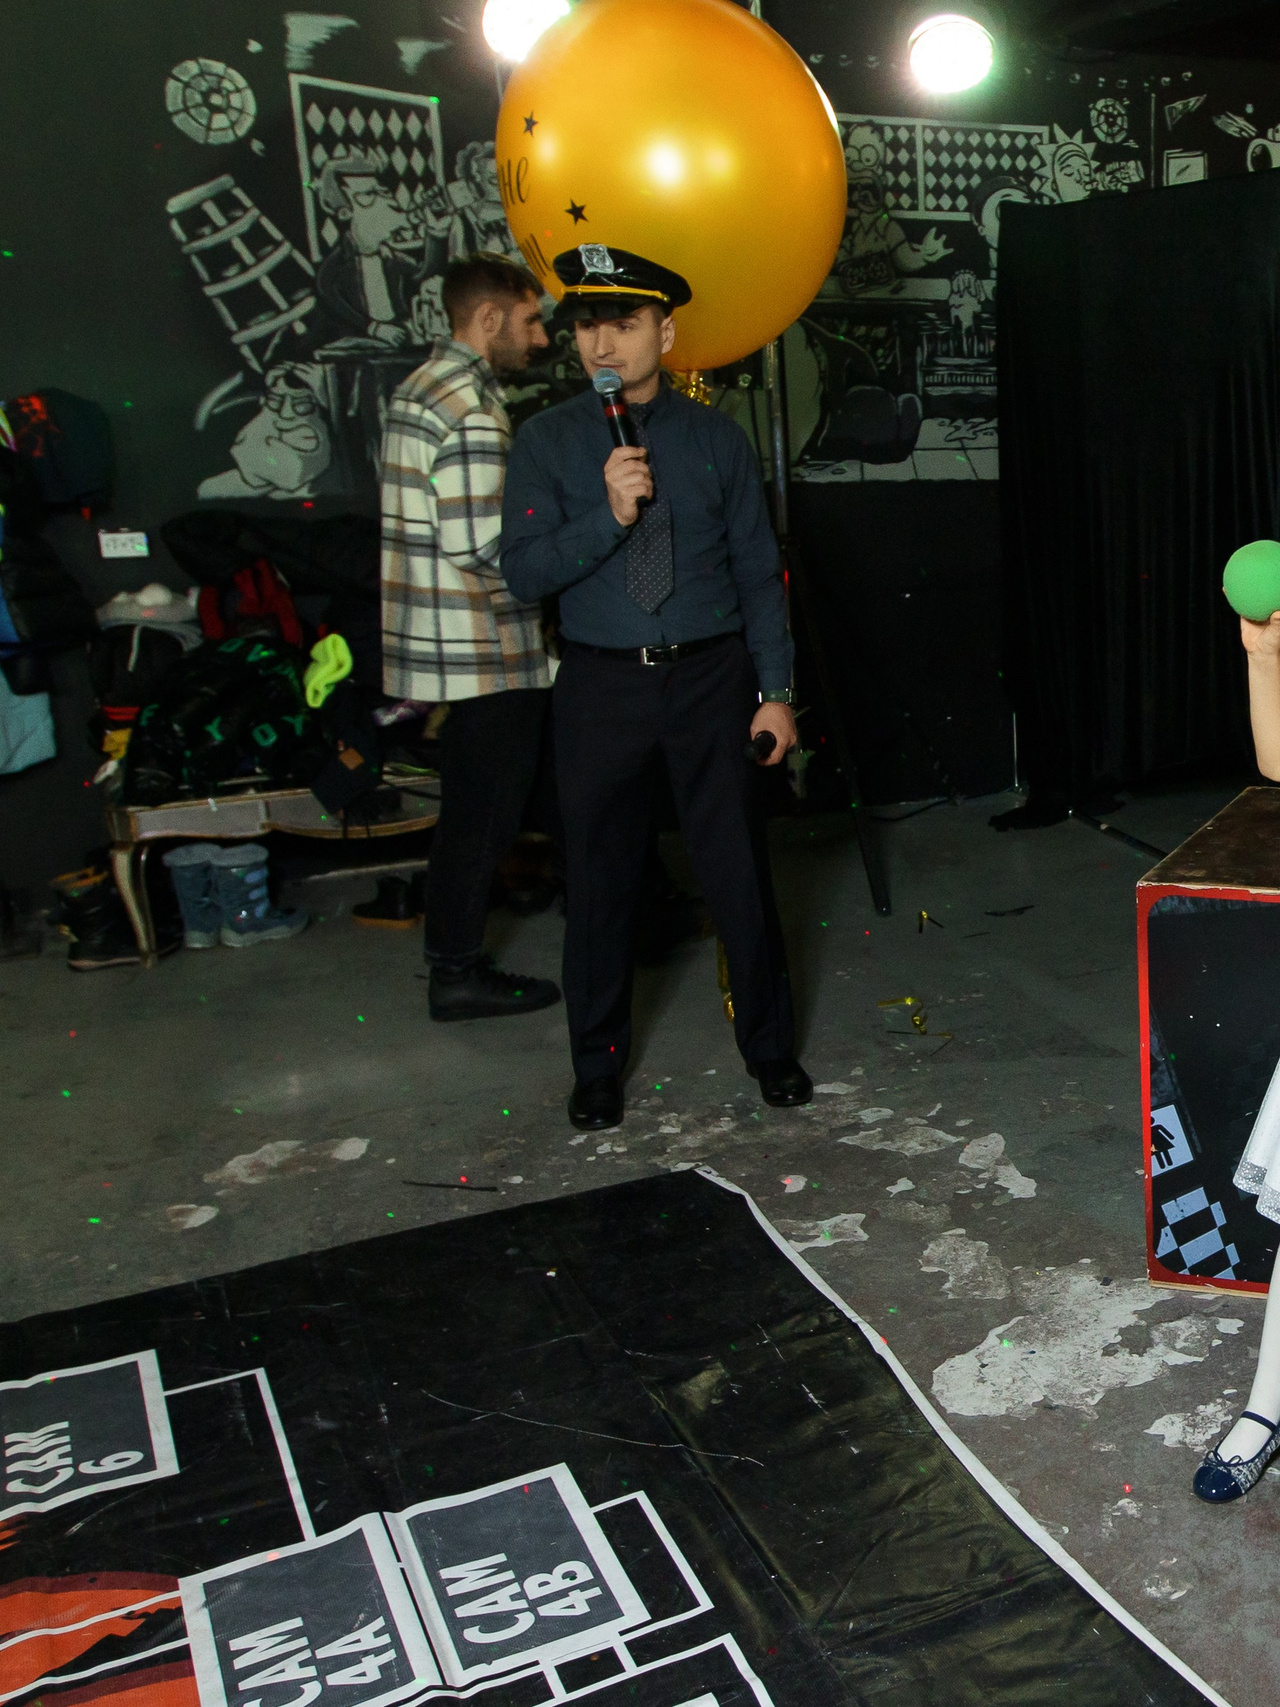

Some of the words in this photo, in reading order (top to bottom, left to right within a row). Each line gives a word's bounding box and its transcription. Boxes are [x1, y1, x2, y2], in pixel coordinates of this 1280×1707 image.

[4, 1421, 74, 1494] CAM
[78, 1450, 144, 1474] 6
[439, 1553, 536, 1644] CAM
[522, 1560, 602, 1617] 4B
[314, 1616, 397, 1685] 4A
